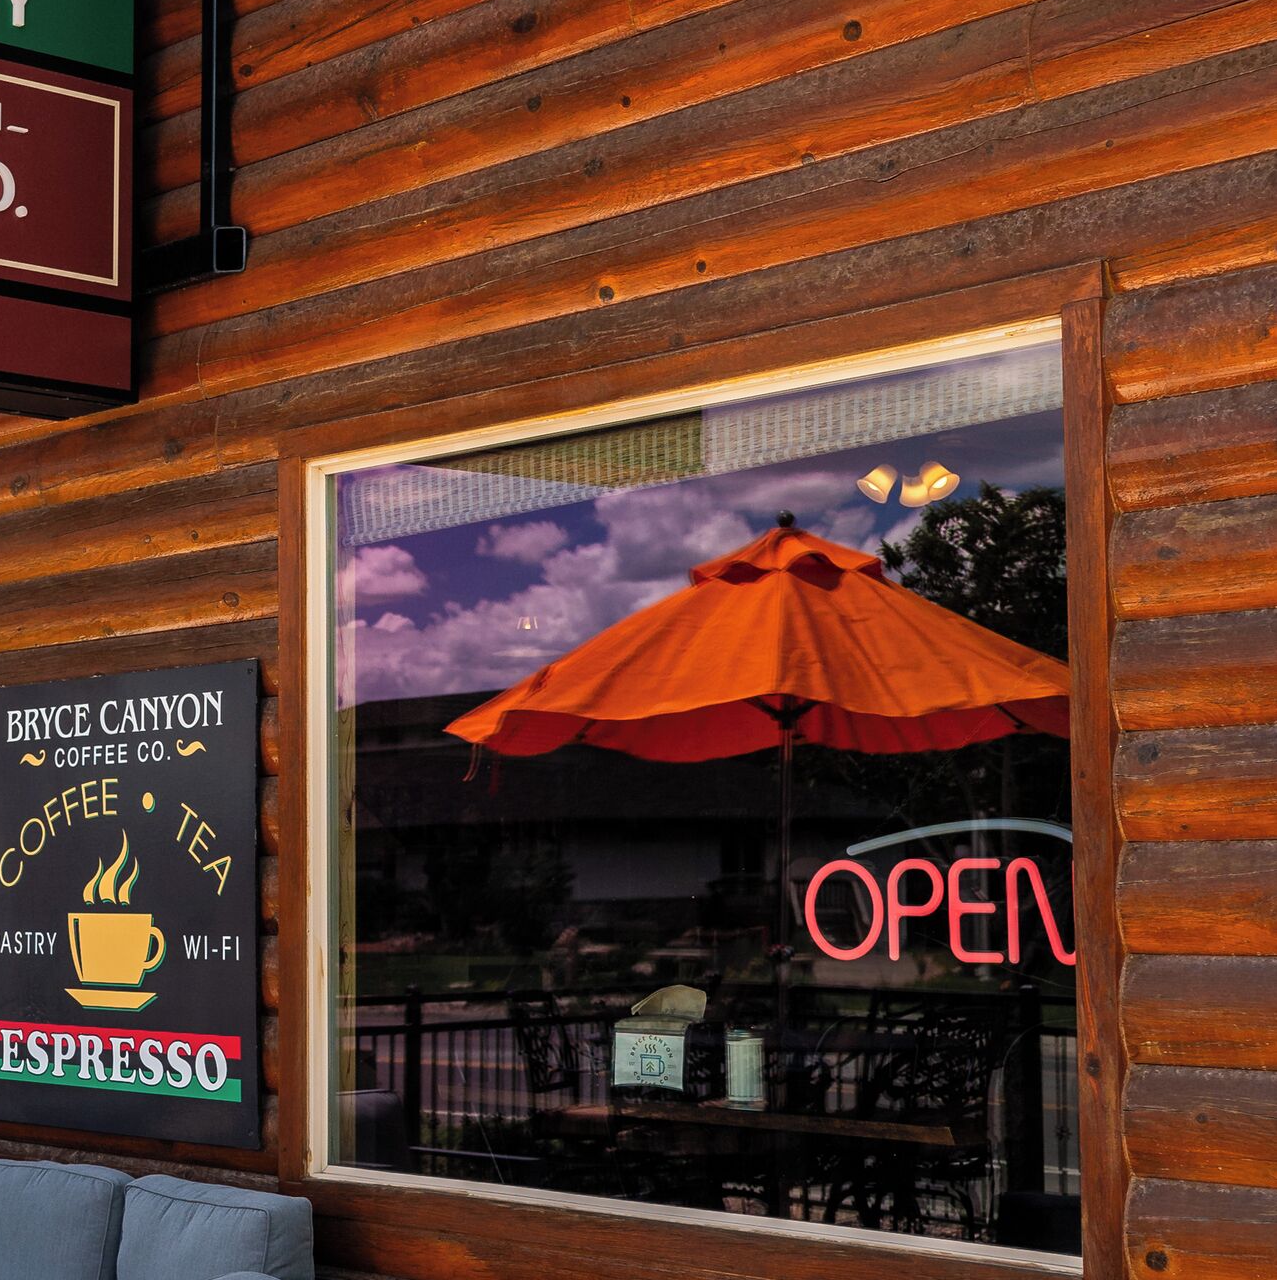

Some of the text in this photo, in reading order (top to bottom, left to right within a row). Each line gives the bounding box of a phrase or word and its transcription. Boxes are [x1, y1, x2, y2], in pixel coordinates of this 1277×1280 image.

[6, 691, 224, 743] BRYCE CANYON
[54, 740, 171, 768] COFFEE CO.
[176, 802, 233, 896] TEA
[805, 857, 1076, 966] OPEN
[183, 934, 241, 961] WI-FI
[0, 1028, 228, 1092] ESPRESSO
[648, 1034, 674, 1058] CANYON
